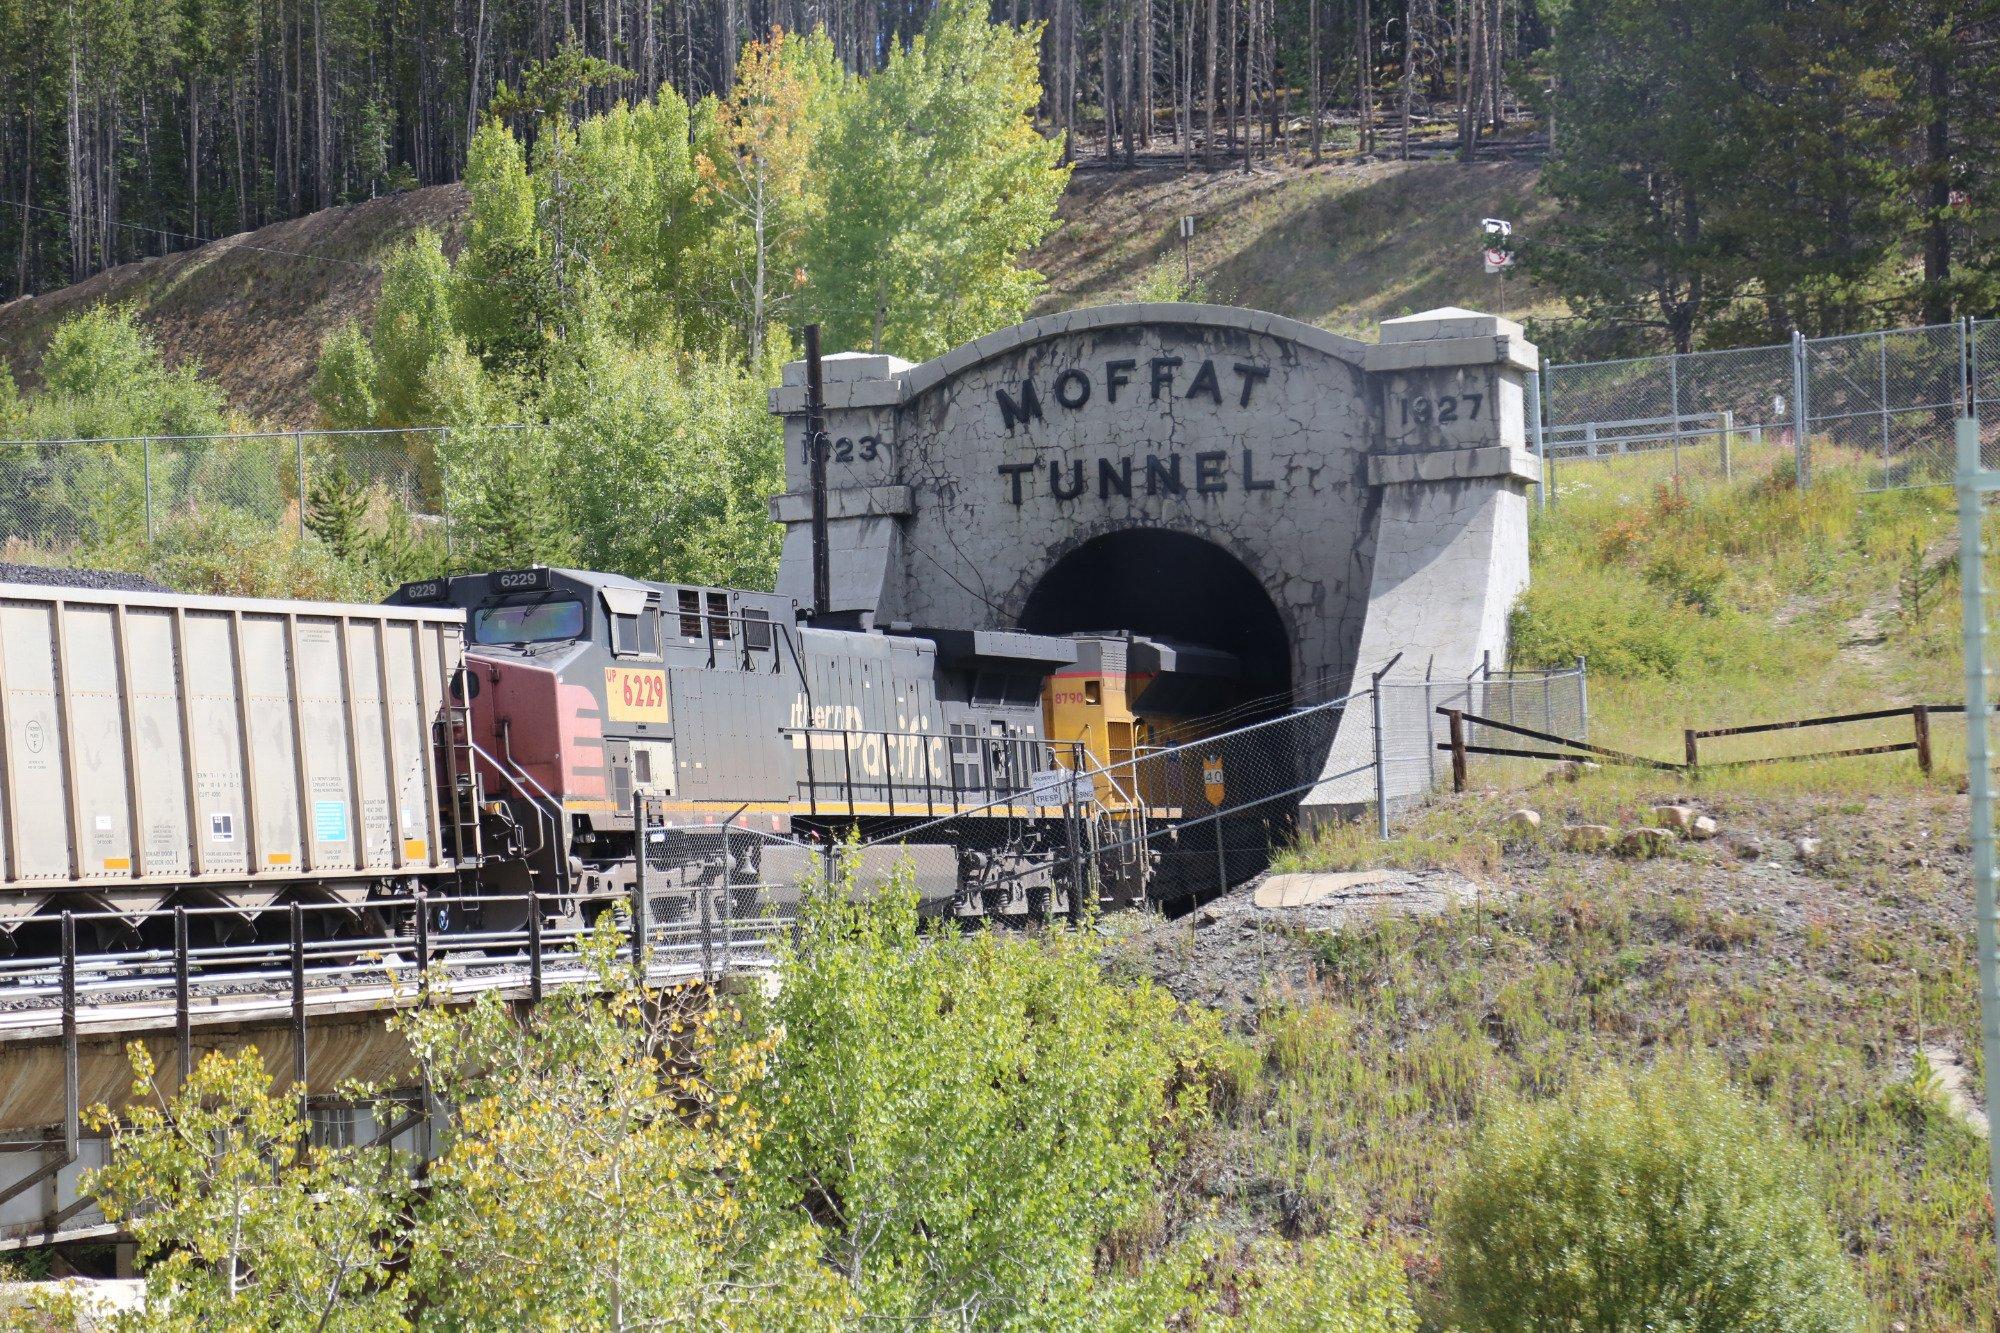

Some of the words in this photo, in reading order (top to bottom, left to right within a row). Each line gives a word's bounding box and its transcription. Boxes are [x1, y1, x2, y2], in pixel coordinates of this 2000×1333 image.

[995, 356, 1271, 430] MOFFAT
[1401, 393, 1483, 425] 1927
[801, 435, 878, 465] 123
[998, 449, 1275, 505] TUNNEL
[408, 583, 437, 598] 6229
[500, 572, 537, 587] 6229
[606, 669, 617, 682] UP
[623, 674, 663, 707] 6229
[1055, 692, 1084, 705] 8790
[844, 706, 943, 780] Pacific
[1205, 770, 1222, 783] 40
